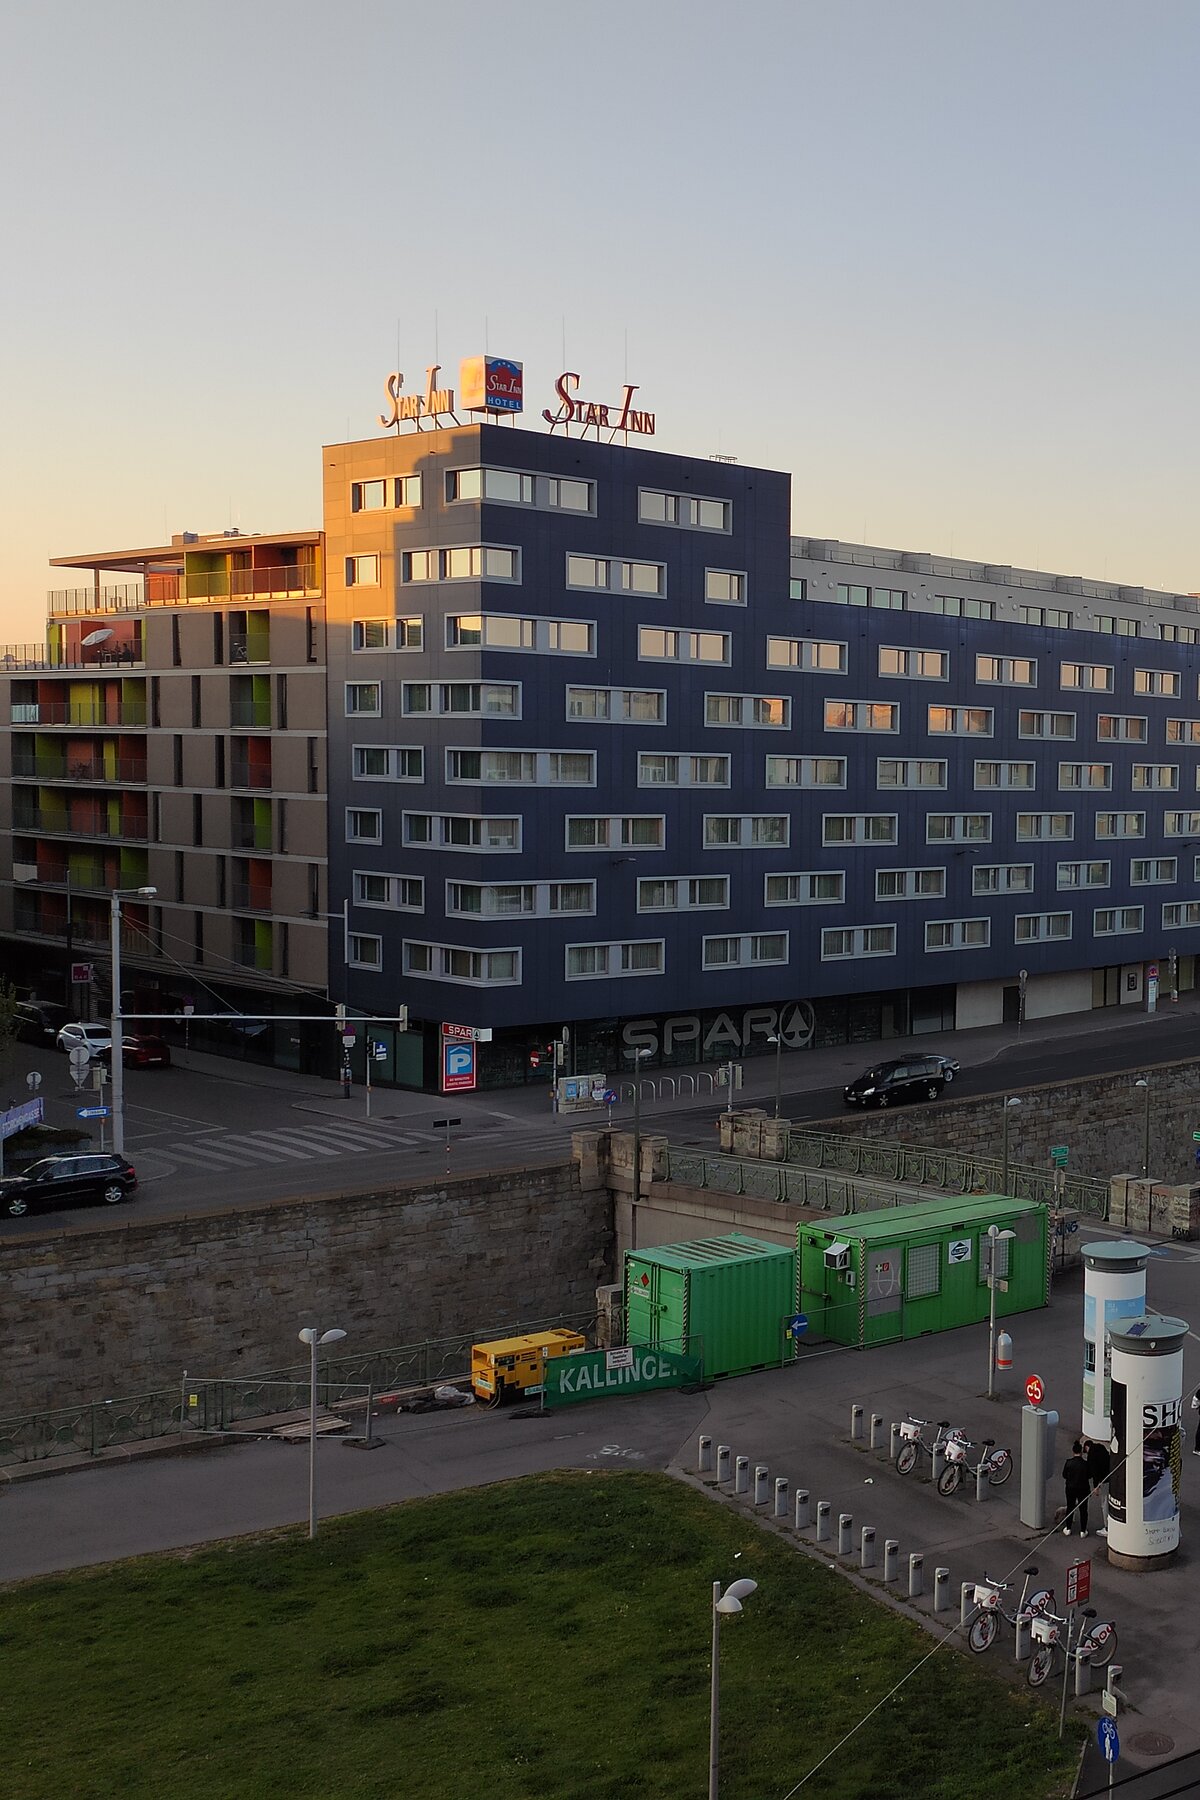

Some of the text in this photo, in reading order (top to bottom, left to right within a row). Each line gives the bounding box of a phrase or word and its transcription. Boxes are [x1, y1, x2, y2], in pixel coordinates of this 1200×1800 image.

[487, 397, 522, 410] HOTEL
[448, 1025, 473, 1038] SPAR
[622, 1007, 778, 1059] SPAR
[450, 1053, 471, 1074] P
